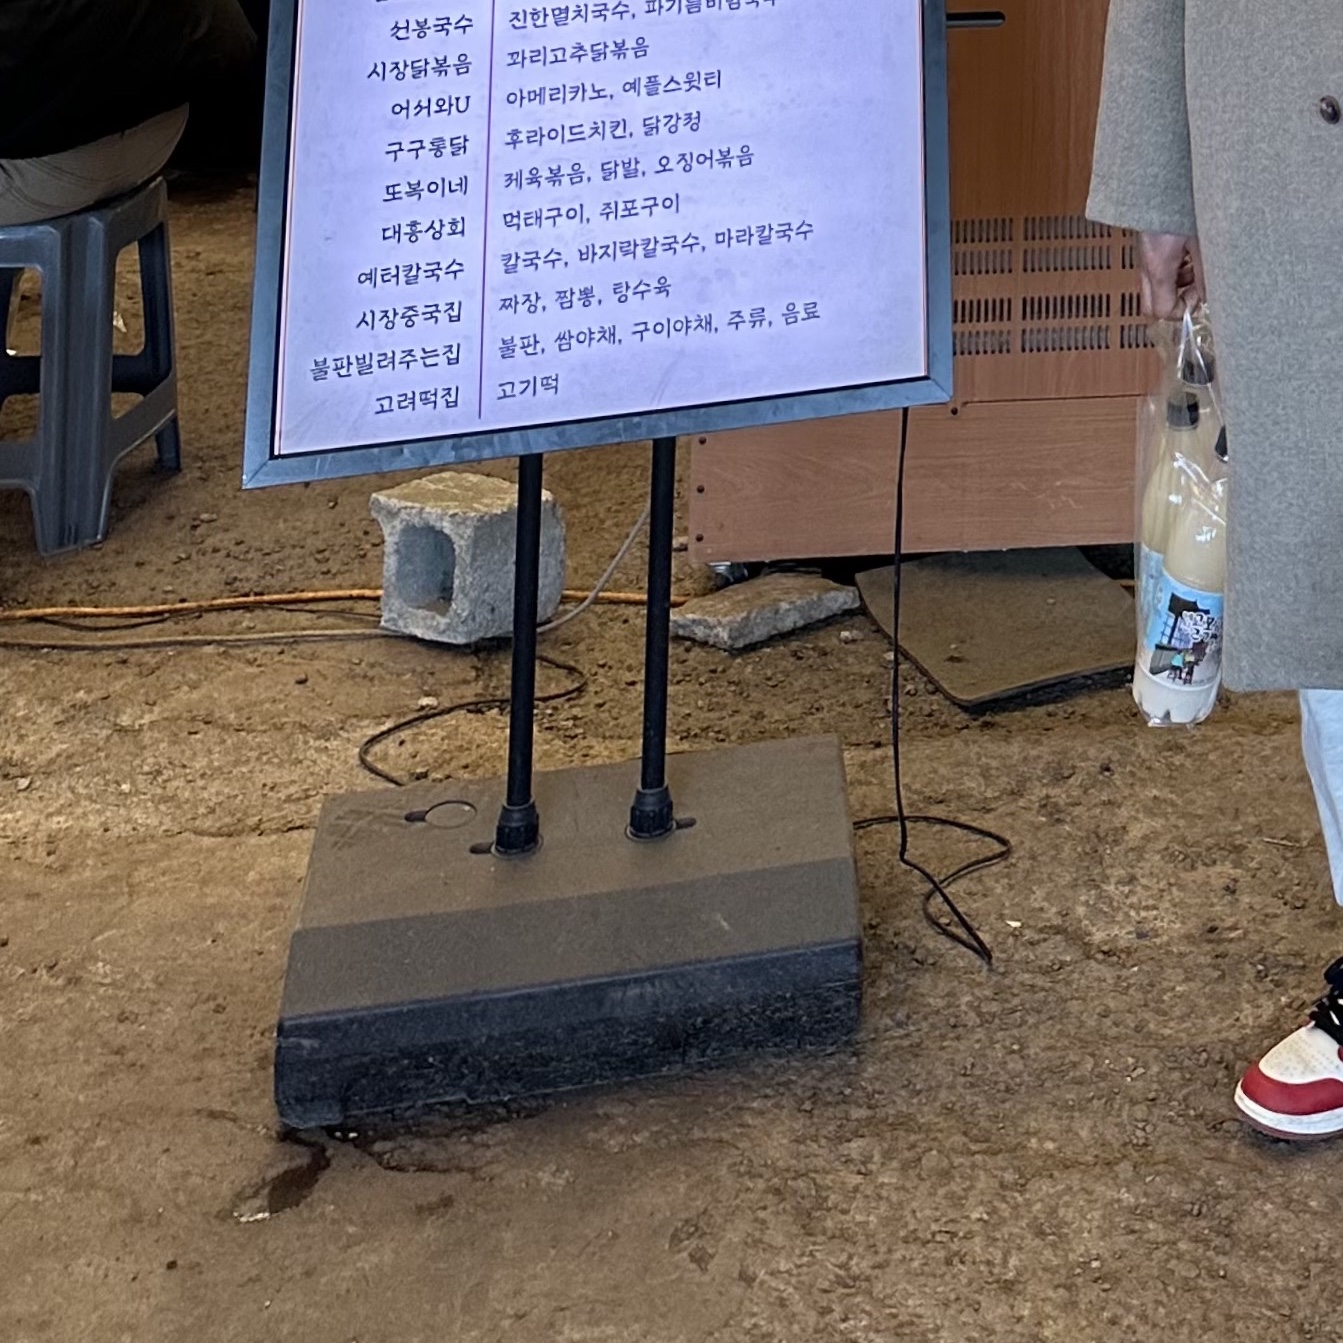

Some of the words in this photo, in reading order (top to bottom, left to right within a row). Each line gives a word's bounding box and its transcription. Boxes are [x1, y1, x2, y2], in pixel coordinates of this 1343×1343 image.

[390, 13, 474, 42] 선봉국수
[508, 0, 636, 31] 진한멸치국수,
[366, 52, 473, 82] 시장닭볶음
[506, 36, 650, 70] 꽈리고추닭볶음
[505, 82, 615, 109] 아메리카노,
[504, 117, 634, 151] 후라이드치킨,
[642, 110, 701, 137] 닭강정
[384, 134, 470, 163] 구구통닭
[503, 162, 592, 191] 제육볶음,
[600, 156, 647, 182] 닭발,
[653, 144, 755, 175] 오징어볶음
[502, 202, 591, 232] 먹태구이,
[599, 192, 680, 222] 쥐포구이
[500, 247, 569, 275] 칼국수,
[577, 231, 706, 265] 바지락칼국수,
[714, 219, 814, 249] 마라칼국수
[357, 257, 465, 290] 예터칼국수
[498, 290, 547, 315] 짜장,
[612, 275, 672, 304] 탕수육
[355, 300, 463, 332] 시장중국집
[498, 332, 546, 360] 불판,
[553, 324, 623, 353] 쌈야채,
[631, 312, 719, 343] 구이야채,
[726, 306, 773, 331] 주류,
[781, 301, 821, 326] 음료
[309, 342, 461, 382] 불판빌려주는집
[374, 384, 460, 415] 고려떡집
[496, 372, 559, 401] 고기떡
